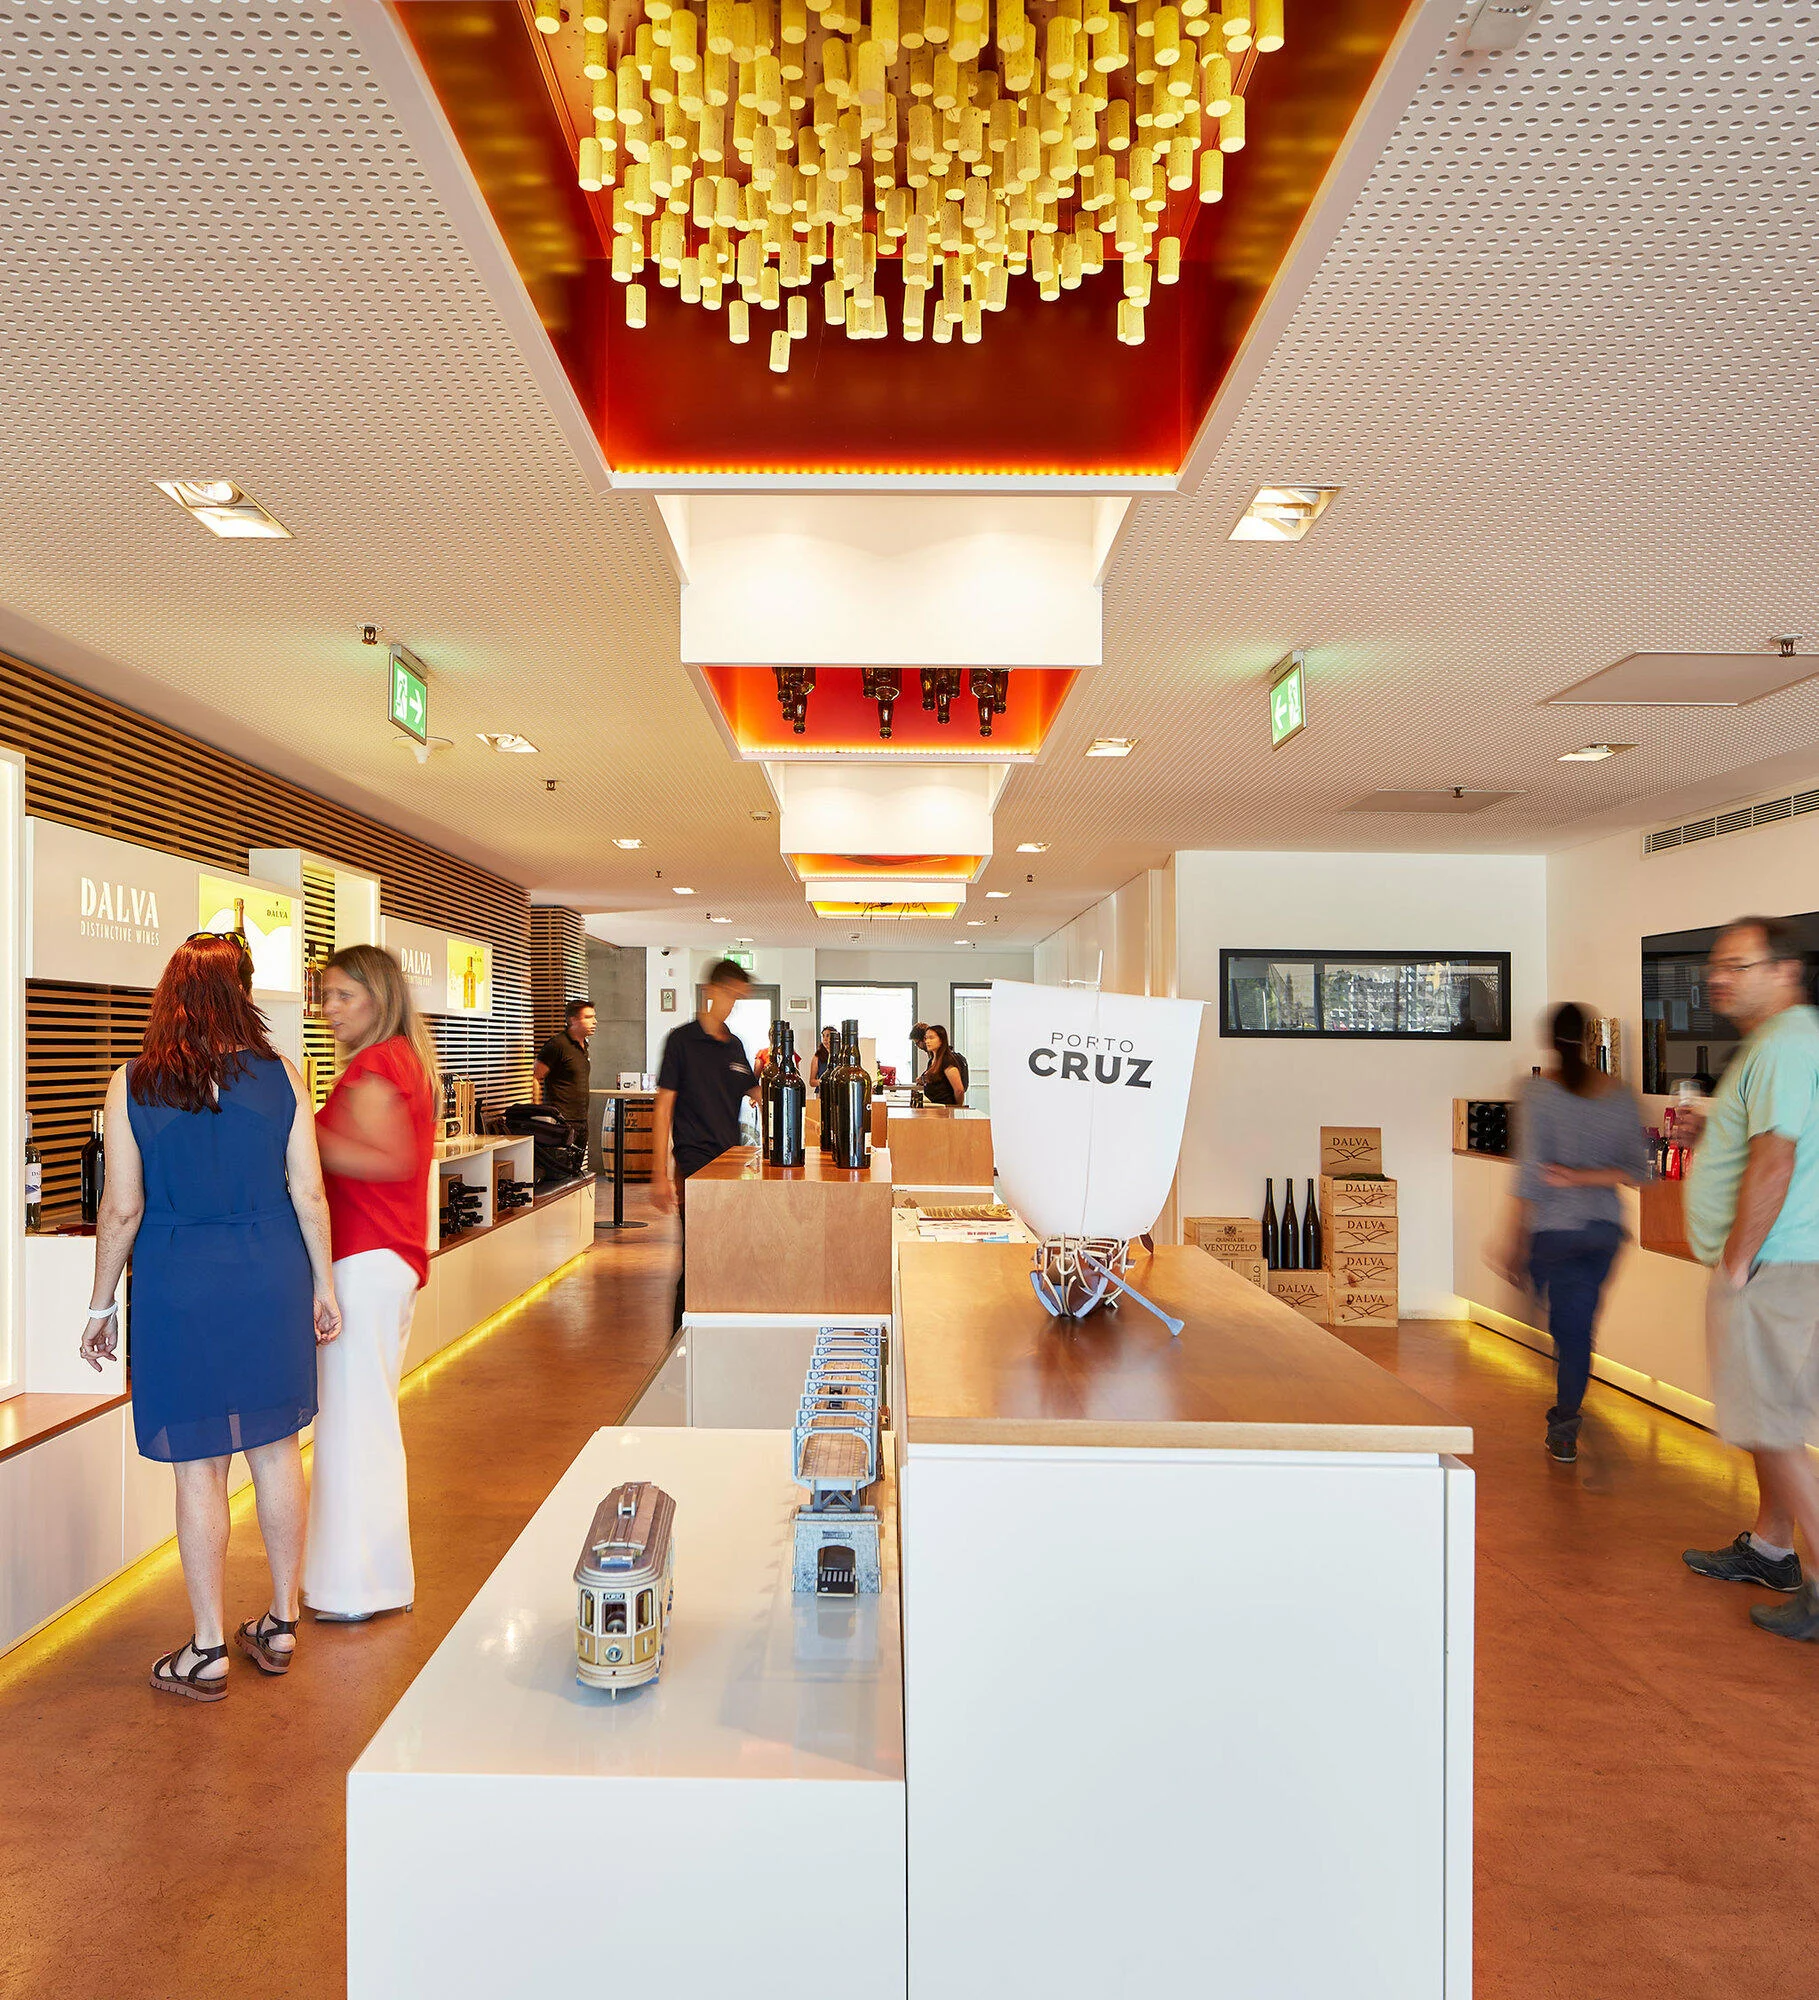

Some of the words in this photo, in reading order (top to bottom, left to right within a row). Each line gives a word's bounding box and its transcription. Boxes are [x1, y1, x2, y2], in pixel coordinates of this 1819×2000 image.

[81, 877, 159, 929] DALVA
[266, 909, 288, 919] DALVA
[80, 920, 132, 943] DISTINCTIVE
[135, 929, 160, 946] WINES
[401, 947, 432, 977] DALVA
[1051, 1032, 1134, 1053] PORTO
[1028, 1047, 1153, 1089] CRUZ
[1332, 1137, 1370, 1147] DALVA
[1345, 1183, 1384, 1193] DALVA
[1347, 1220, 1386, 1230] DALVA
[1204, 1243, 1258, 1252] VENTOZELO
[1347, 1257, 1385, 1266] DALVA
[1277, 1284, 1316, 1293] DALVA
[1347, 1294, 1385, 1303] DALVA
